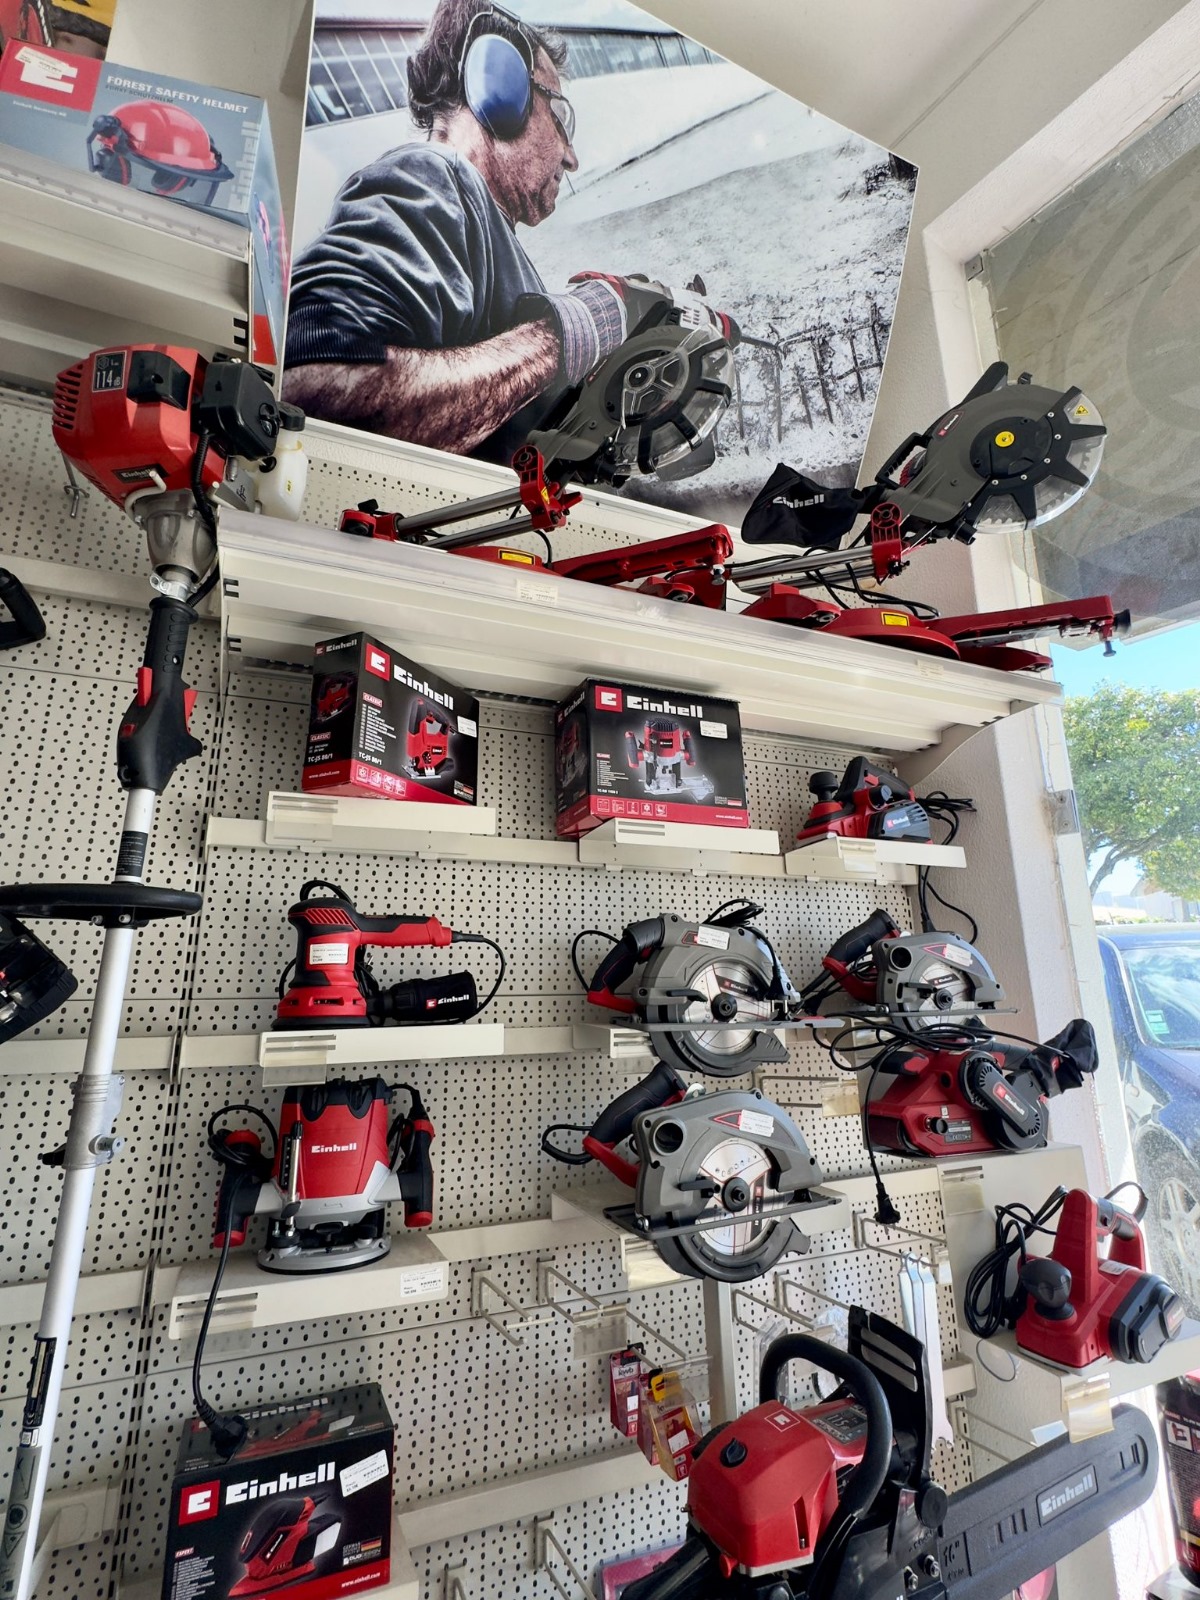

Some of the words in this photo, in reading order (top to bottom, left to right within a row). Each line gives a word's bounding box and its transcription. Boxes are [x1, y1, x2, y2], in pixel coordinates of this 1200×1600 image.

[106, 75, 153, 93] FOREST
[155, 86, 200, 104] SAFETY
[201, 97, 249, 114] HELMET
[96, 369, 113, 389] 114
[326, 638, 358, 652] Einhell
[393, 664, 454, 711] Einhell
[626, 694, 704, 719] Einhell
[437, 993, 470, 1005] Einhell
[311, 1142, 357, 1154] Einhell
[225, 1461, 336, 1506] Einhell
[1040, 1472, 1093, 1517] Einhell
